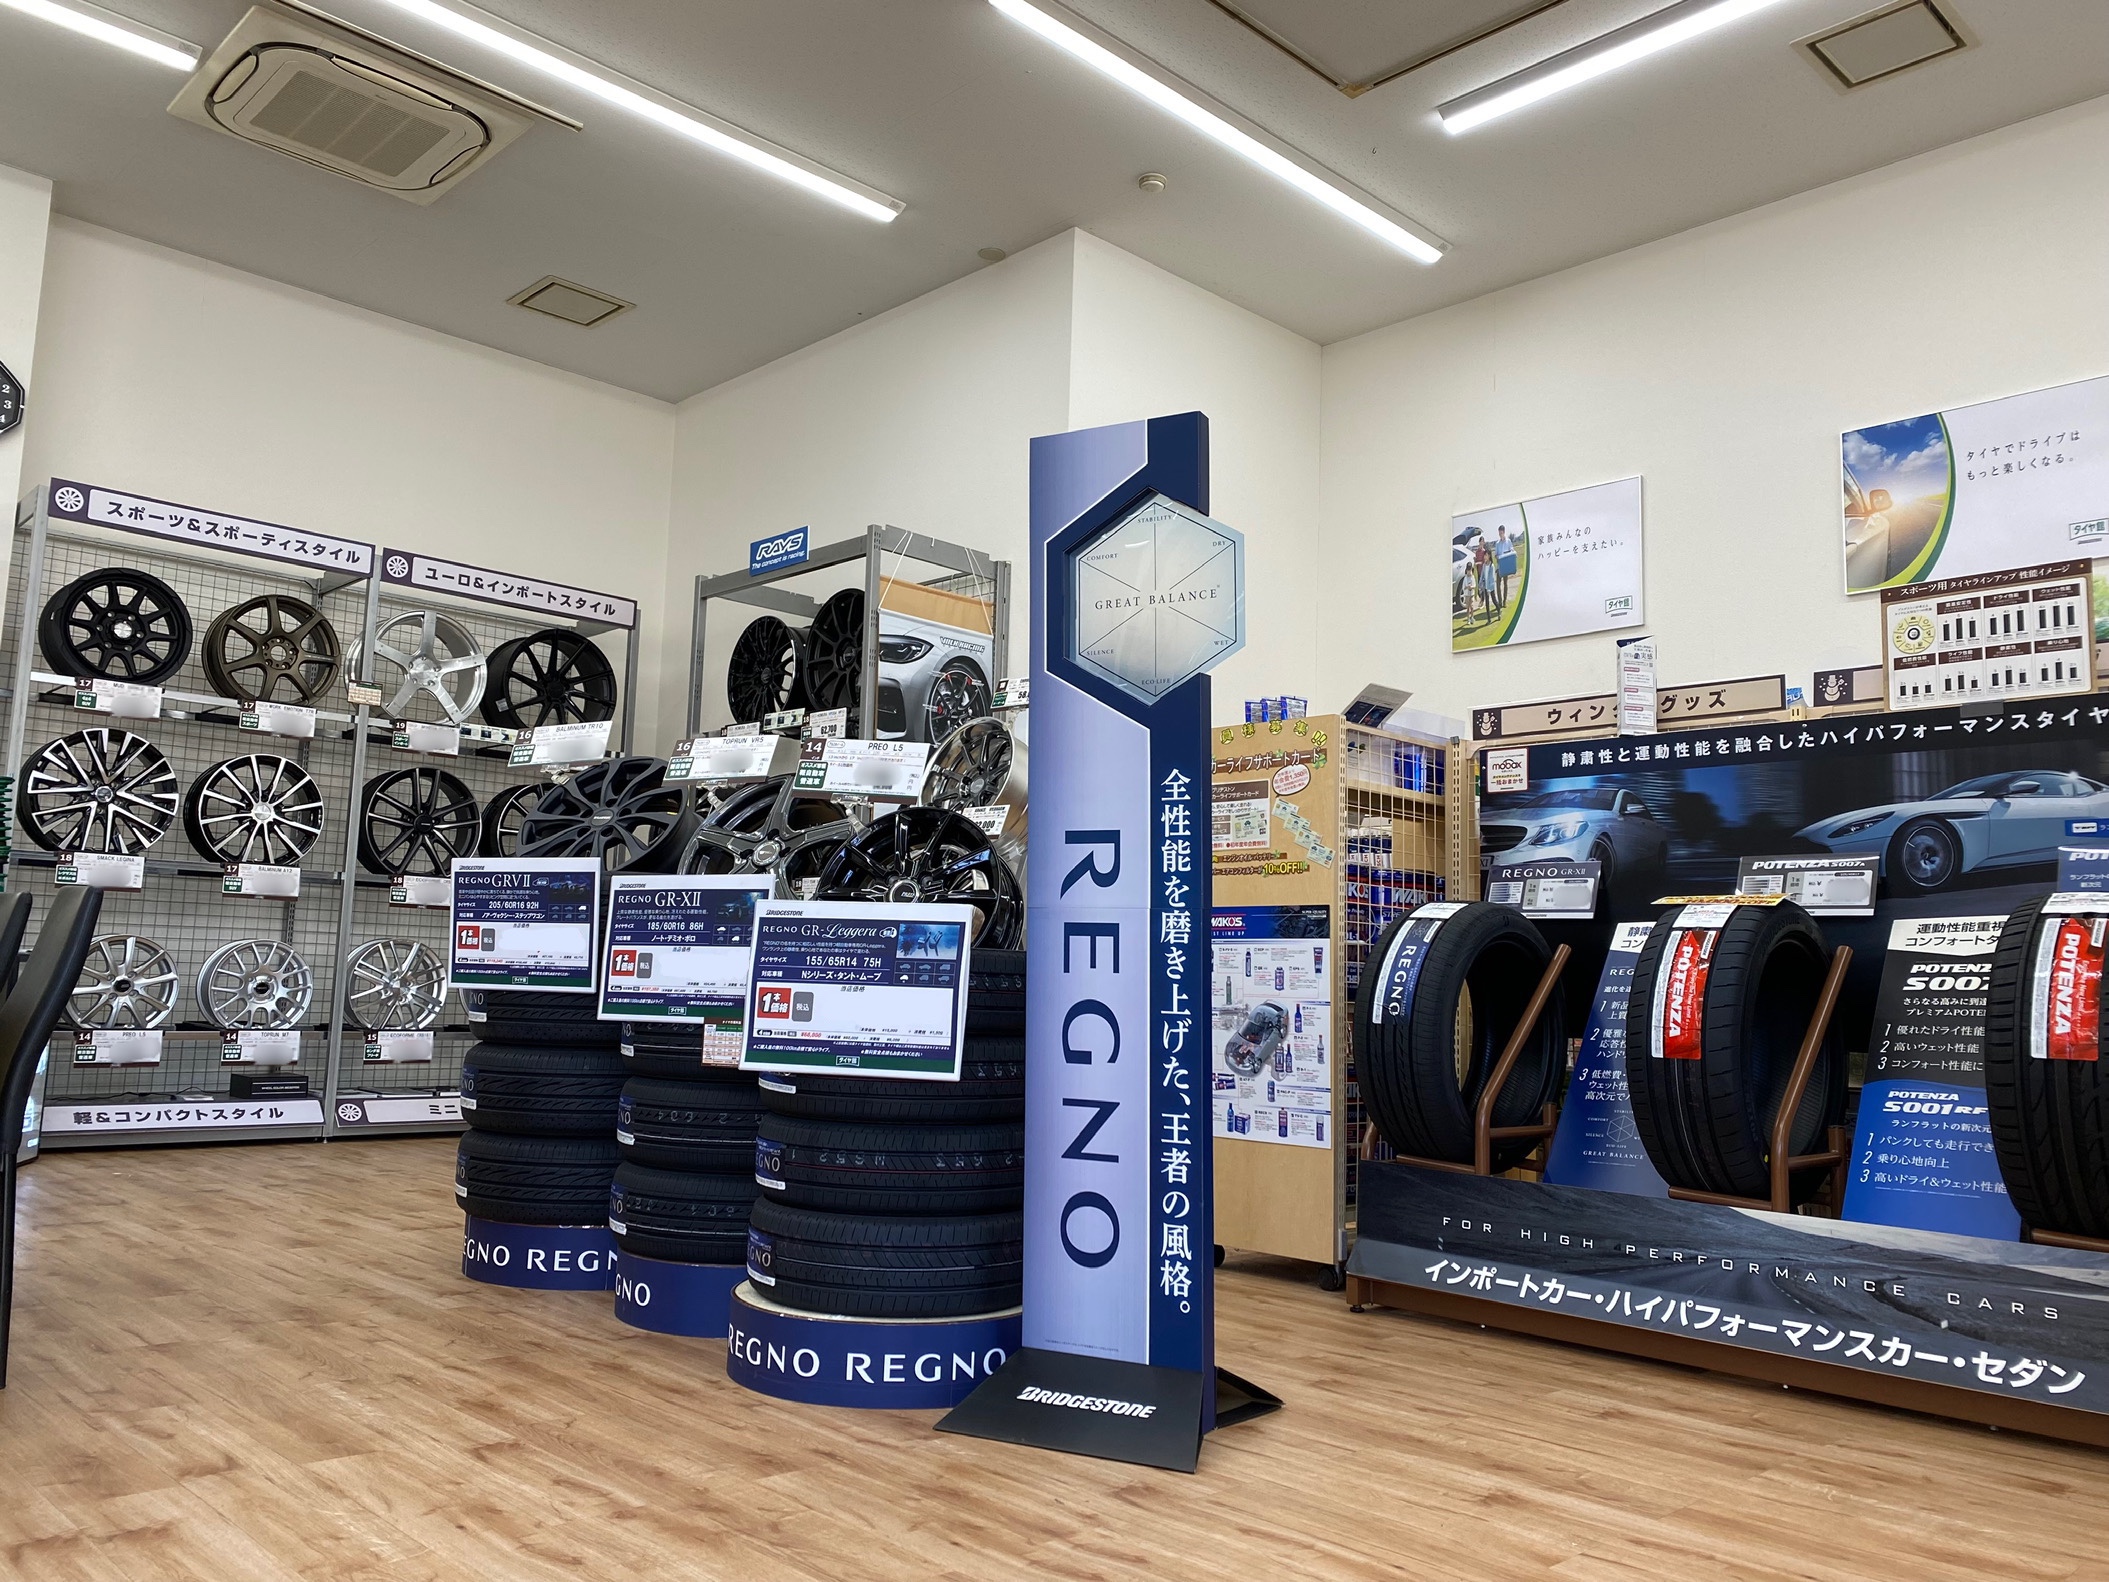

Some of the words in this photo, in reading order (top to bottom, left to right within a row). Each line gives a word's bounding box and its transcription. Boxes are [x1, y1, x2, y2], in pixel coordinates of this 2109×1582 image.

[2, 384, 10, 393] 2
[4, 400, 12, 409] 3
[1966, 430, 2081, 462] タイヤでドライブは
[1966, 454, 2075, 481] もっと楽しくなる。
[1137, 514, 1172, 524] STABILITY
[107, 501, 361, 564] スポーツ&スポーティスタイル
[1537, 526, 1592, 546] 家族みんなの
[756, 533, 804, 560] RAYS
[1537, 540, 1625, 560] ハッピーを支えたい。
[1086, 553, 1118, 561] COMFORT
[1900, 580, 1948, 596] スポーツ用
[1950, 573, 2017, 589] タイヤラインアップ
[2019, 563, 2070, 580] 性能イメージ
[425, 567, 616, 616] ユーロ&インポートスタイル
[1095, 596, 1141, 610] GREAT
[1149, 588, 1218, 605] BALANCE
[79, 679, 92, 687] 17
[1547, 690, 1727, 726] ウィングッズ
[518, 730, 532, 740] 16
[676, 741, 691, 751] 16
[805, 741, 822, 753] 14
[867, 742, 888, 751] PREO
[1492, 759, 1522, 770] mobox
[60, 854, 72, 862] 18
[226, 865, 238, 873] 17
[1752, 860, 1830, 870] POTENZA
[1502, 867, 1558, 878] REGNO
[393, 876, 403, 884] 18
[458, 877, 491, 885] REGNO
[488, 901, 525, 910] 205/60R16
[526, 901, 539, 909] 92H
[618, 895, 651, 904] REGNO
[647, 921, 685, 931] 185/60R16
[689, 921, 704, 931] 86H
[762, 925, 797, 933] REGNO
[801, 923, 876, 939] GR-Leggera
[806, 955, 858, 968] 155/65R14
[863, 957, 882, 968] 75H
[761, 970, 783, 978] 対応車種
[801, 971, 882, 981] Nシリーズ・タント・ムーブ
[1388, 945, 1418, 1016] REGNO
[2054, 932, 2081, 1035] POTENZA
[1669, 945, 1694, 1038] POTENZA
[796, 1003, 810, 1012] 税込
[226, 1032, 237, 1040] 14
[1590, 1027, 1600, 1041] 2
[1884, 1023, 1891, 1037] 1
[1897, 1024, 1986, 1037] 優れたドライ性能
[79, 1033, 91, 1041] 14
[367, 1033, 377, 1041] 15
[1160, 768, 1192, 1314] 全性能を磨き上げた、王者の風格。
[1060, 829, 1121, 1269] REGNO
[1879, 1040, 1890, 1054] 2
[1893, 1042, 1980, 1055] 高いウェット性能
[838, 1057, 858, 1065] タイヤ館
[1877, 1057, 1888, 1070] 3
[1891, 1059, 1984, 1071] コンフォート性能に
[1579, 1068, 1589, 1081] 3
[1888, 1090, 1960, 1101] POTENZA
[73, 1107, 285, 1126] 軽&コンパクトスタイル
[1891, 1119, 1992, 1134] ランフラットの新次元
[1867, 1133, 1875, 1147] 1
[1609, 1152, 1644, 1160] BALANCE
[1862, 1151, 1873, 1165] 2
[1876, 1153, 1950, 1169] 乗り心地向上
[1859, 1169, 1870, 1183] 3
[1874, 1172, 2008, 1195] 高いドライ&ウェット性能
[1443, 1217, 1492, 1233] FOR
[1521, 1229, 1594, 1249] HIGH
[1626, 1244, 1905, 1297] PERFORMANCE
[1947, 1292, 2058, 1320] CARS
[1424, 1259, 2086, 1394] インポートカー・ハイパフォーマンスカー・セダン
[728, 1322, 820, 1378] REGNO
[845, 1347, 1007, 1384] REGNO
[1017, 1385, 1157, 1419] BRIDGESTONE
